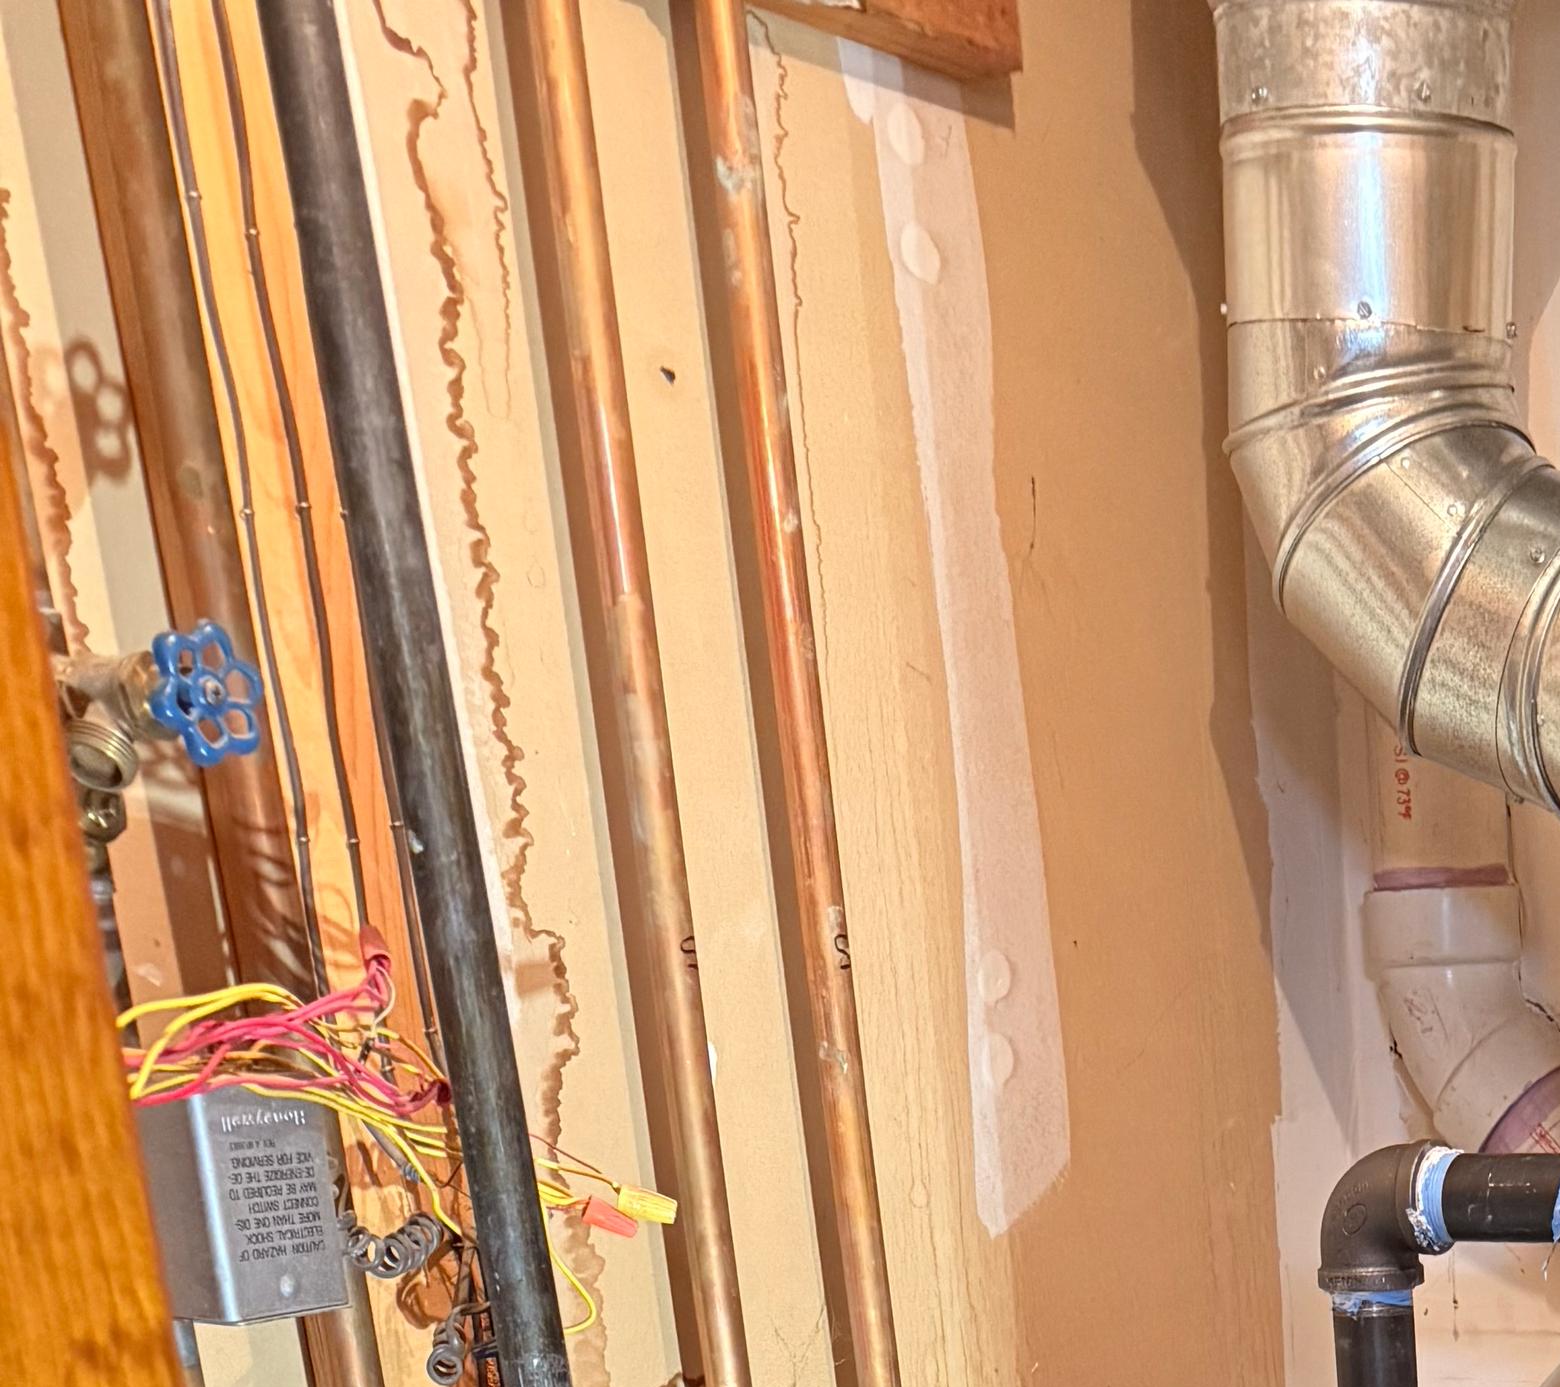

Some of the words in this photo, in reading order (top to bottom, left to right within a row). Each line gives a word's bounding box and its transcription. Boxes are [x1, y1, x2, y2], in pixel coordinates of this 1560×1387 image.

[221, 1110, 305, 1132] Honeywell
[276, 1153, 293, 1166] FOR
[296, 1152, 312, 1164] VICE
[246, 1171, 261, 1183] THE
[286, 1184, 296, 1195] BE
[300, 1181, 316, 1193] MAY
[229, 1188, 240, 1200] TO
[254, 1217, 270, 1228] ONE
[272, 1214, 295, 1226] THAN
[298, 1211, 321, 1223] MORE
[246, 1231, 273, 1244] SHOCK
[239, 1250, 249, 1262] OF
